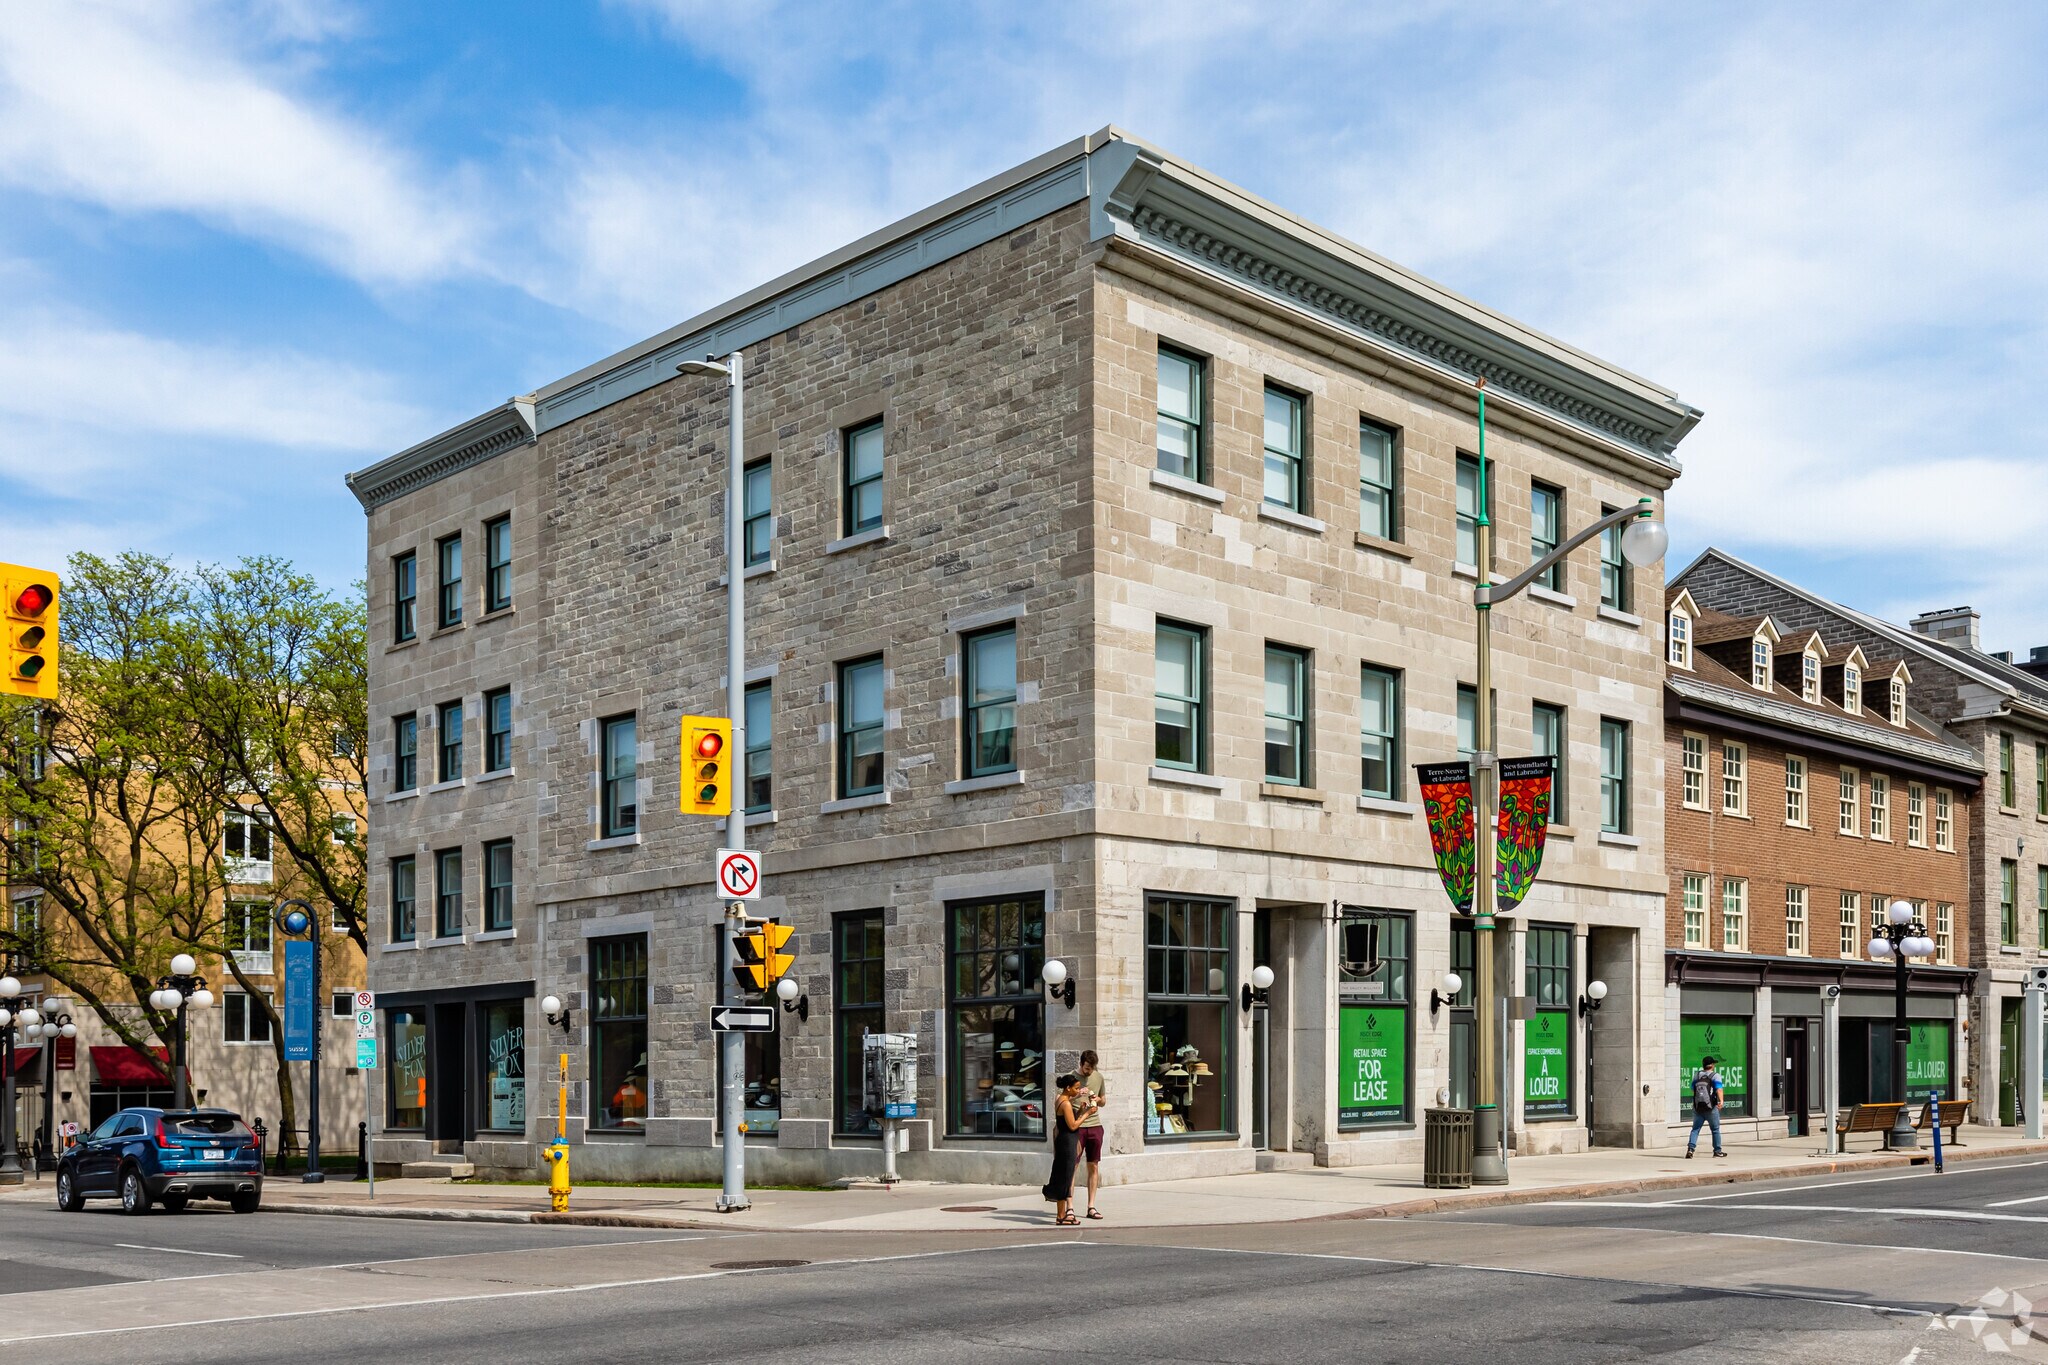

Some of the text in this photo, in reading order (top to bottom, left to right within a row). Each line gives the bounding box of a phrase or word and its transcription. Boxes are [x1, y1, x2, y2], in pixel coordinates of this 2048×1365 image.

[1503, 761, 1548, 770] Newfoundland
[397, 1035, 426, 1068] SILVER
[489, 1027, 525, 1062] SILVER
[1353, 1048, 1387, 1058] RETAIL SPACE
[403, 1056, 426, 1088] FOX
[497, 1052, 523, 1080] FOX
[1358, 1059, 1382, 1079] FOR
[1541, 1055, 1548, 1076] À
[1917, 1058, 1945, 1078] À LOUER
[1353, 1080, 1388, 1101] LEASE
[1530, 1077, 1559, 1095] LOUER
